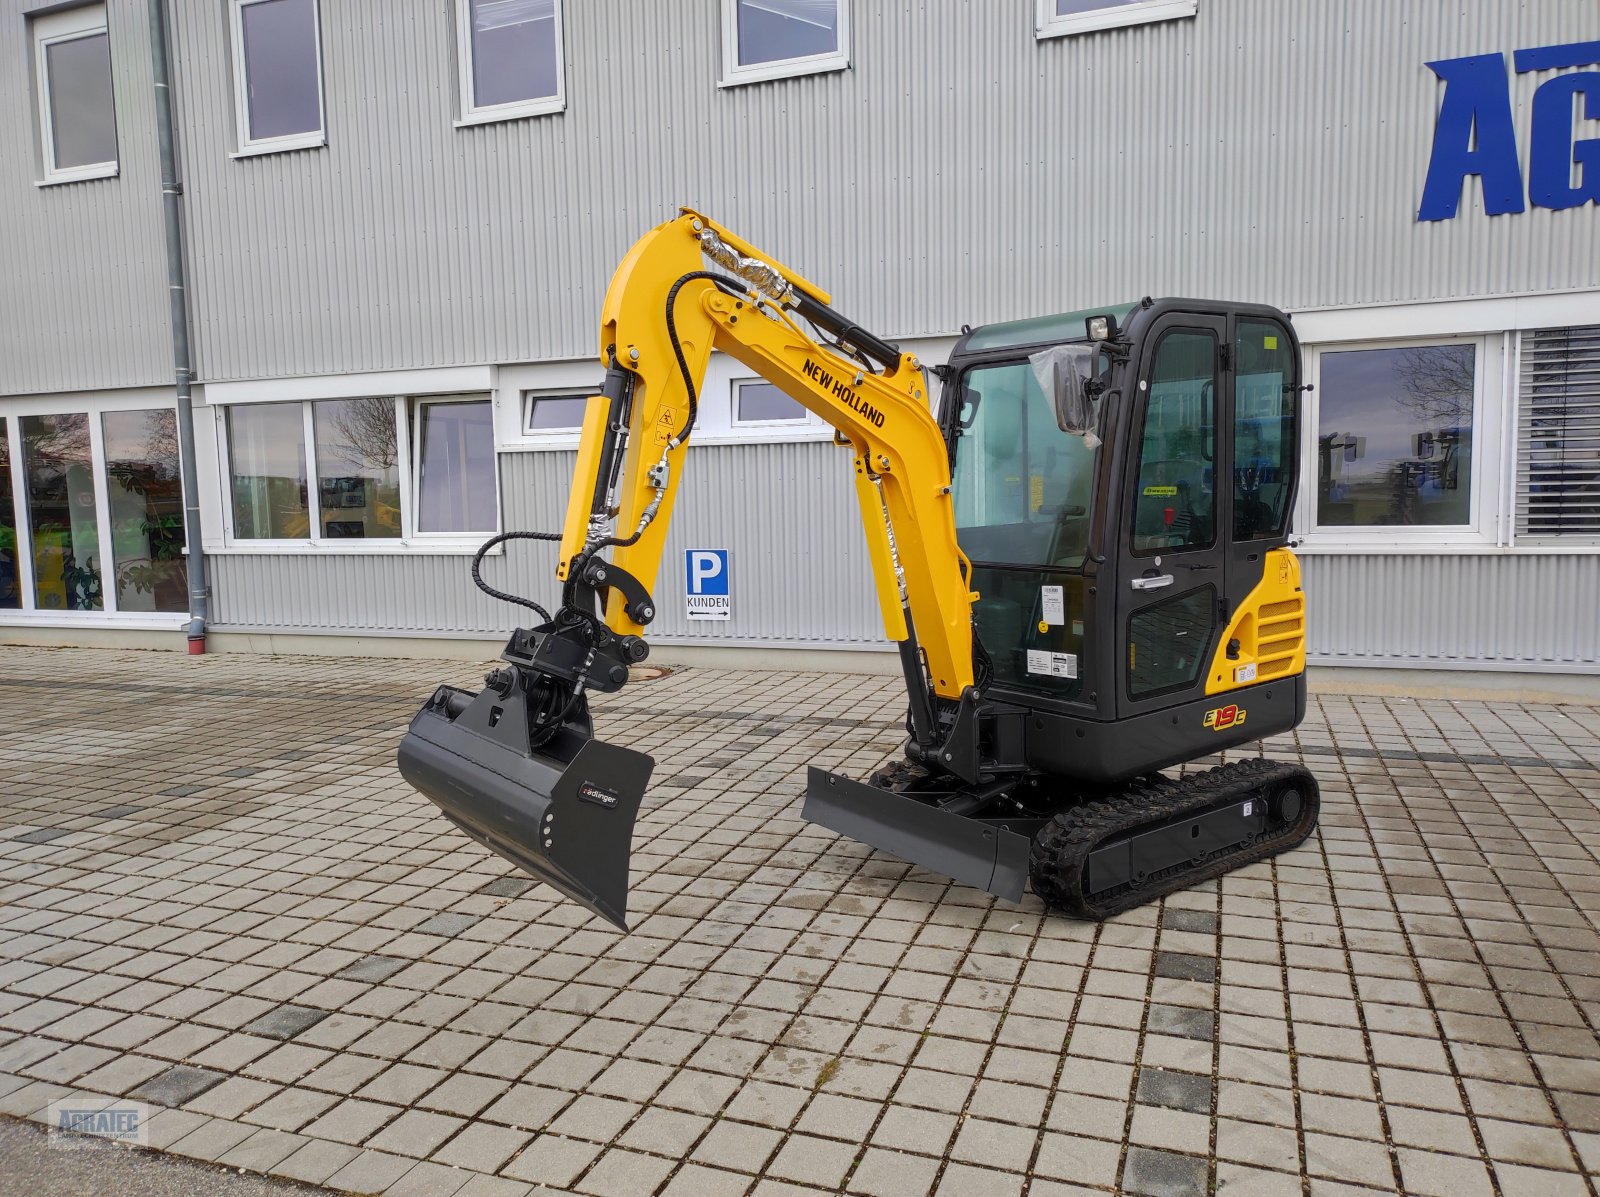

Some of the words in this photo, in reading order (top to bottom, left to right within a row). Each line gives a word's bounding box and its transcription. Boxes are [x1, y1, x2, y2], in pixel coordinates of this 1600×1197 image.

[802, 358, 833, 390] NEW
[831, 380, 885, 429] HOLLAND
[691, 551, 722, 594] P
[687, 597, 729, 608] KUNDEN
[1204, 705, 1246, 729] E19C
